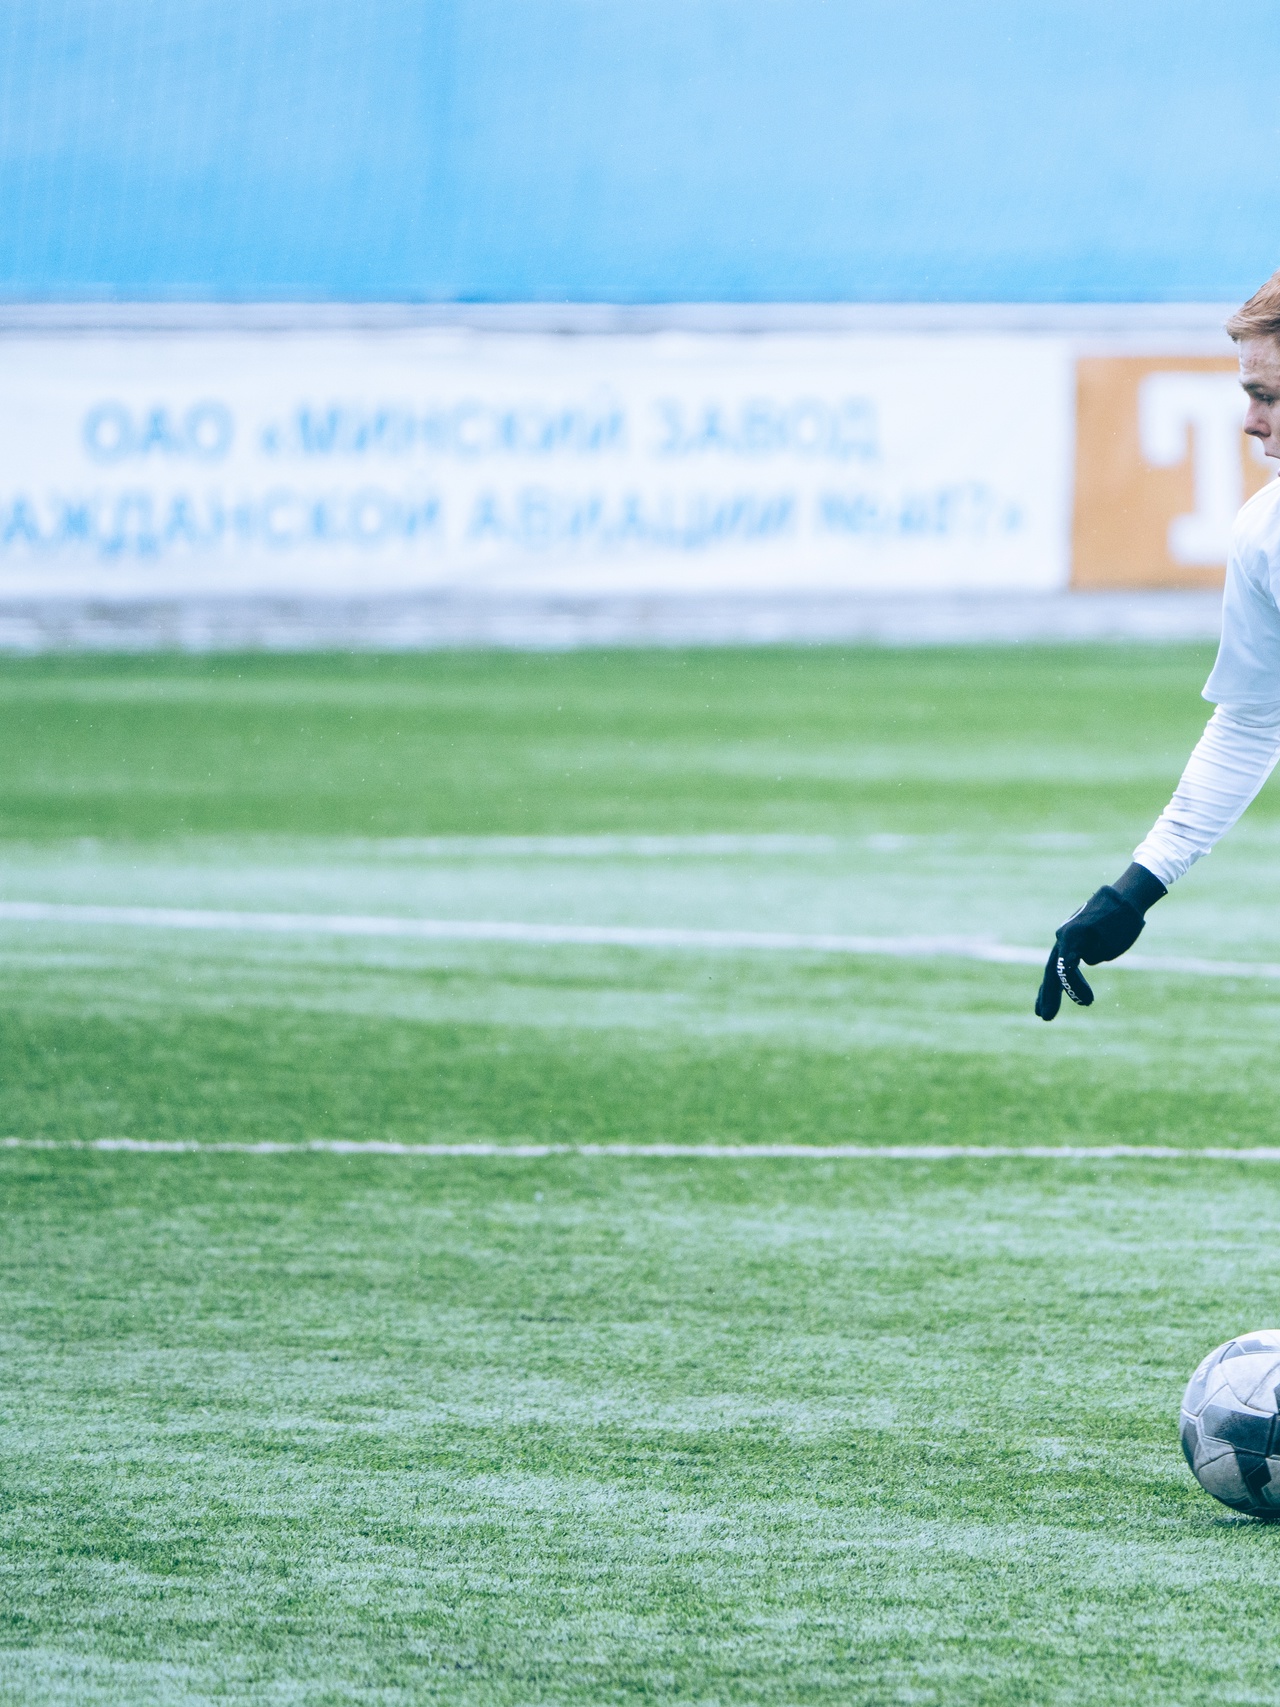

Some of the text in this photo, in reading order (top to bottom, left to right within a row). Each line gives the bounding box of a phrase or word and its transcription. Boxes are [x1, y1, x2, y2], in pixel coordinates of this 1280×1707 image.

[82, 397, 236, 467] ОАО
[647, 395, 884, 466] ЗАВОД
[1056, 956, 1083, 1004] uhlsport
